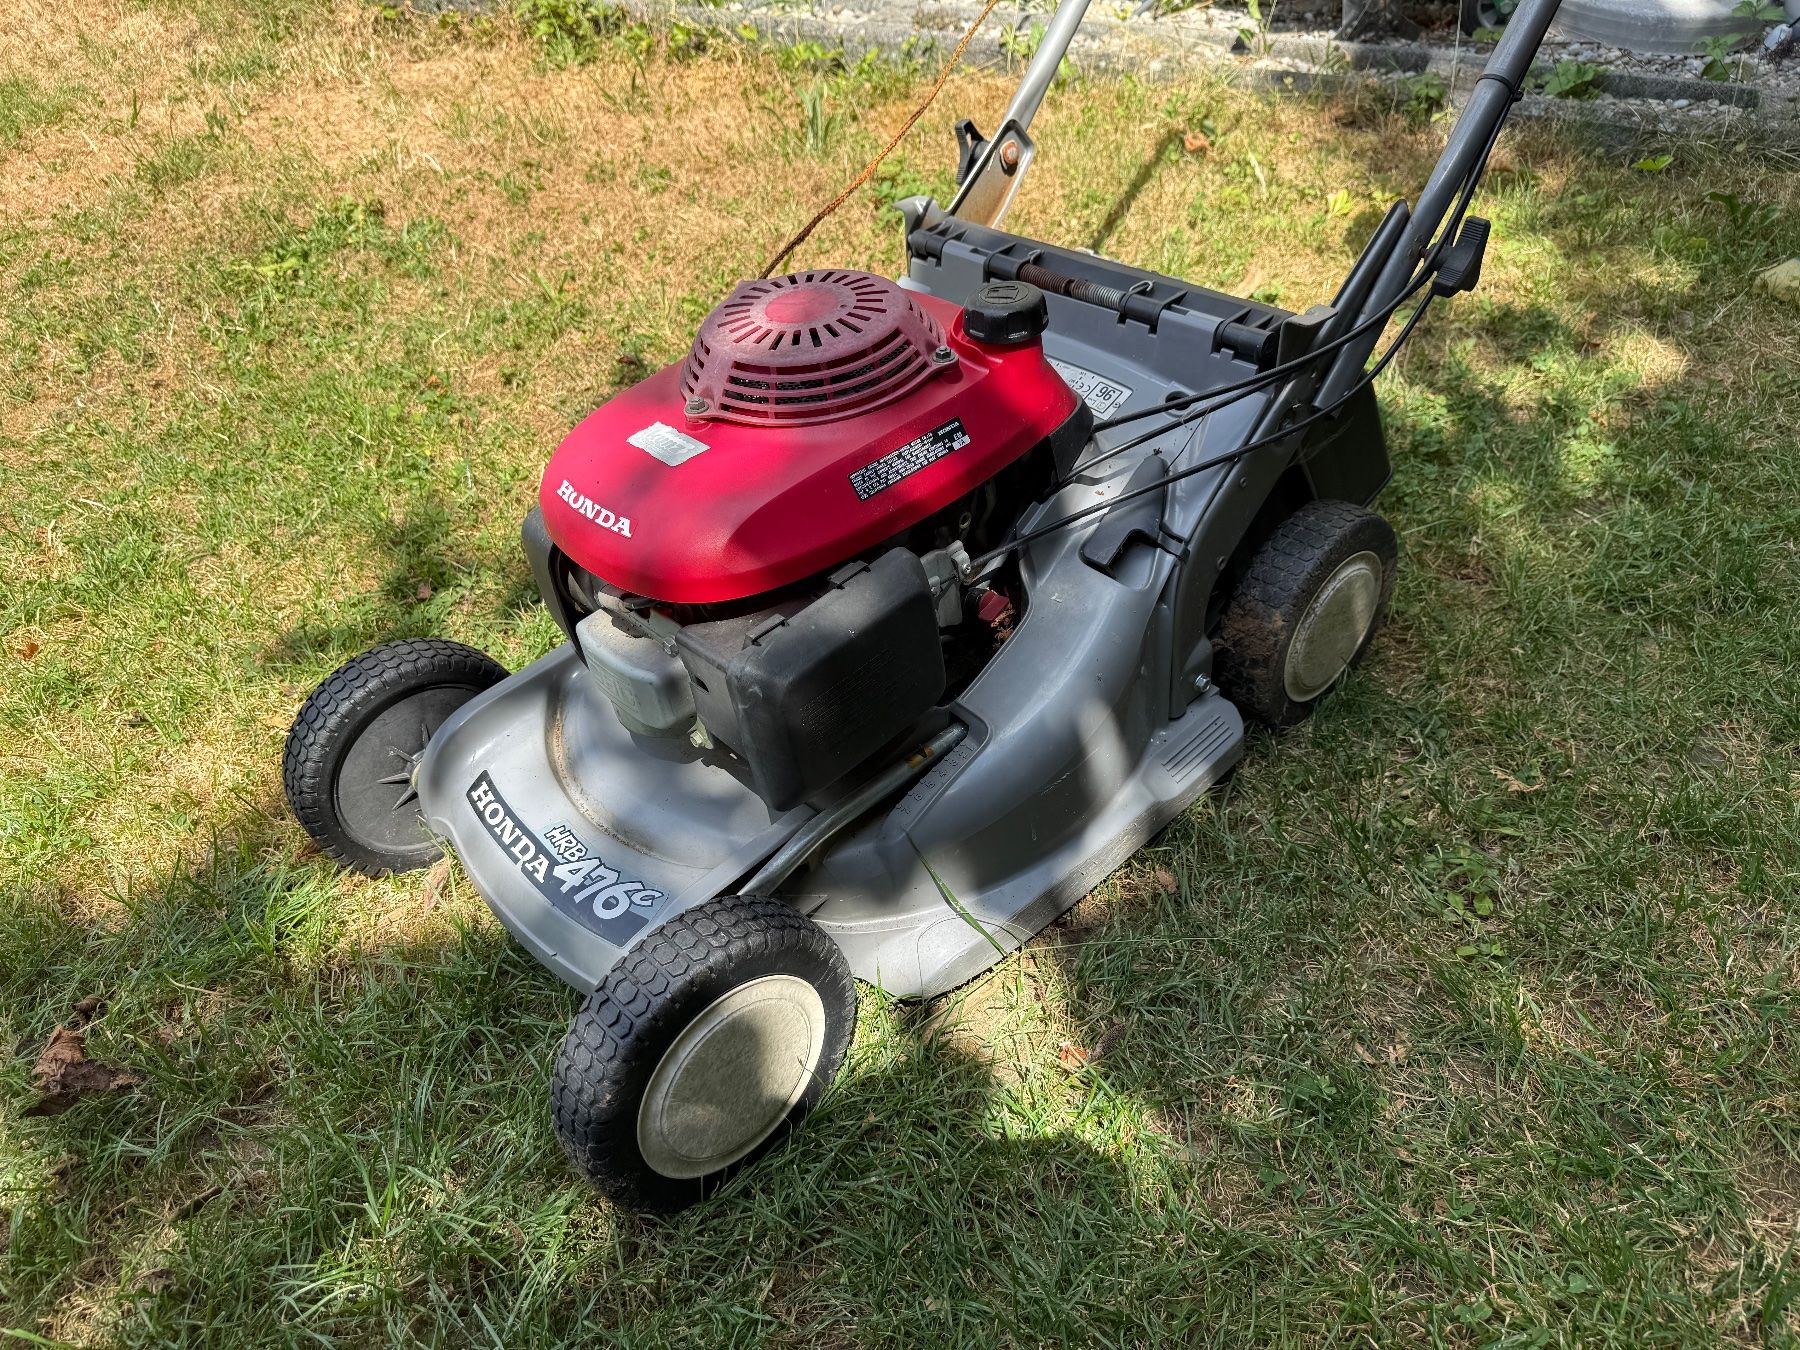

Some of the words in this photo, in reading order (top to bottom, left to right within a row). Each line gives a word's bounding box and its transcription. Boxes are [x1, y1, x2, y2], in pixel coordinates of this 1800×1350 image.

[1095, 386, 1116, 401] 96
[556, 479, 632, 538] HONDA
[470, 780, 550, 884] HONDA
[544, 824, 589, 863] HRB
